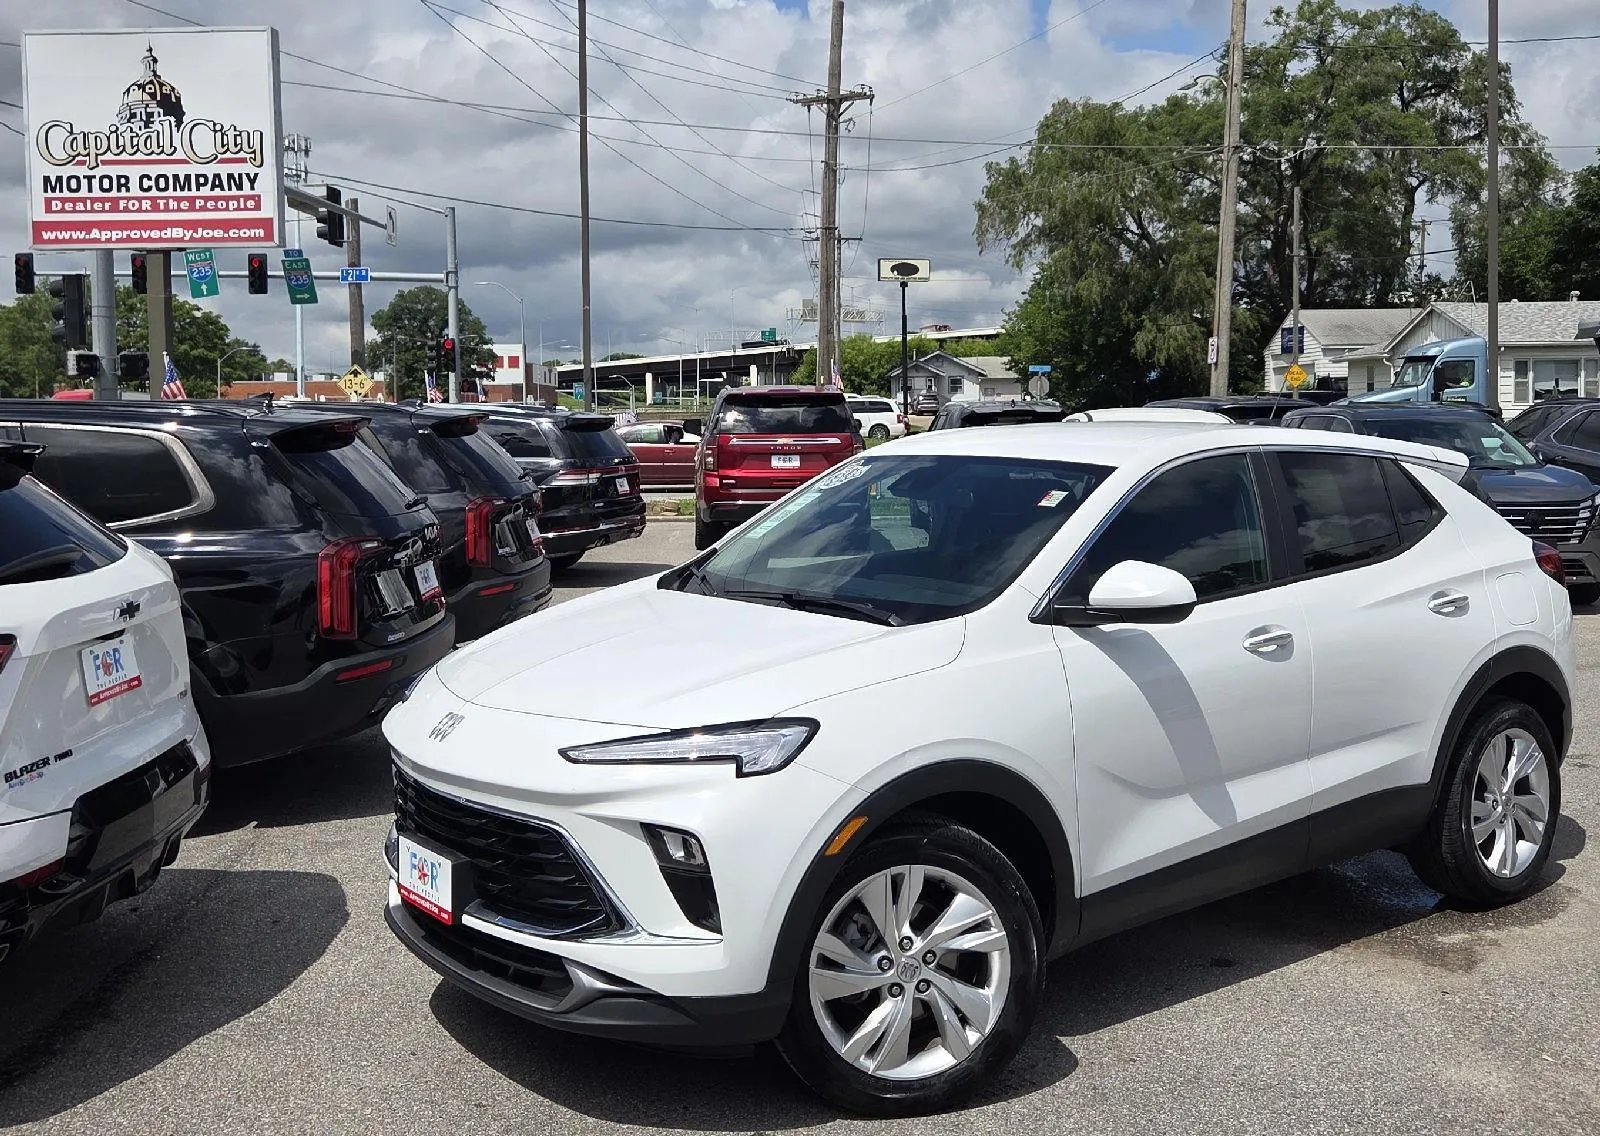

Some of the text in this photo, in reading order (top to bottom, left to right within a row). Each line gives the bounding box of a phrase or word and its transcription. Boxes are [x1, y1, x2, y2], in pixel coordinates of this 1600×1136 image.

[36, 118, 264, 170] Capital City
[43, 172, 259, 194] MOTOR COMPANY
[51, 199, 112, 212] Dealer
[119, 199, 152, 211] FOR
[154, 199, 189, 210] The
[41, 227, 265, 242] www.ApprovedByJoe.com
[187, 251, 211, 261] WEST
[192, 266, 212, 278] 235
[285, 261, 306, 269] EAST
[290, 275, 309, 285] 235
[92, 647, 125, 682] FOR
[4, 756, 51, 783] BLAZER
[409, 851, 439, 893] FOR
